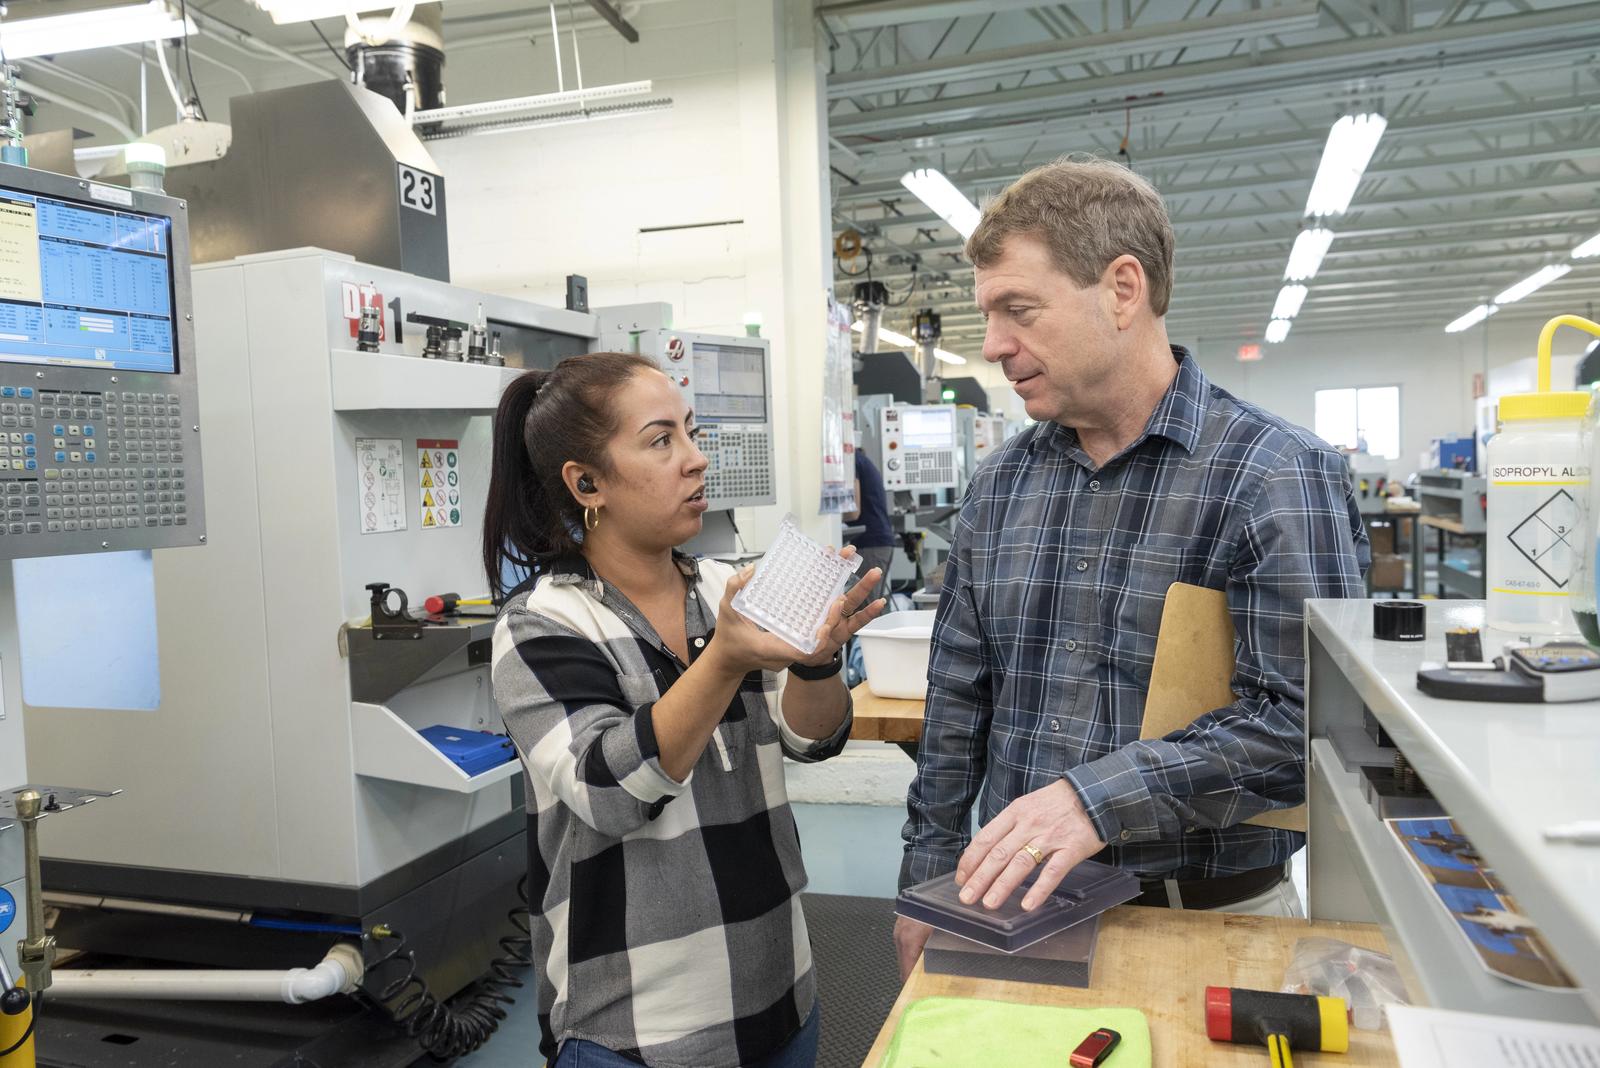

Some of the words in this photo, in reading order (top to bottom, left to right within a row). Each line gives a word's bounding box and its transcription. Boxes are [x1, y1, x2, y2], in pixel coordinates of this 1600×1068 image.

[403, 170, 433, 210] 23
[1492, 466, 1557, 478] ISOPROPYL
[1558, 526, 1565, 534] 3
[1531, 548, 1537, 556] 1
